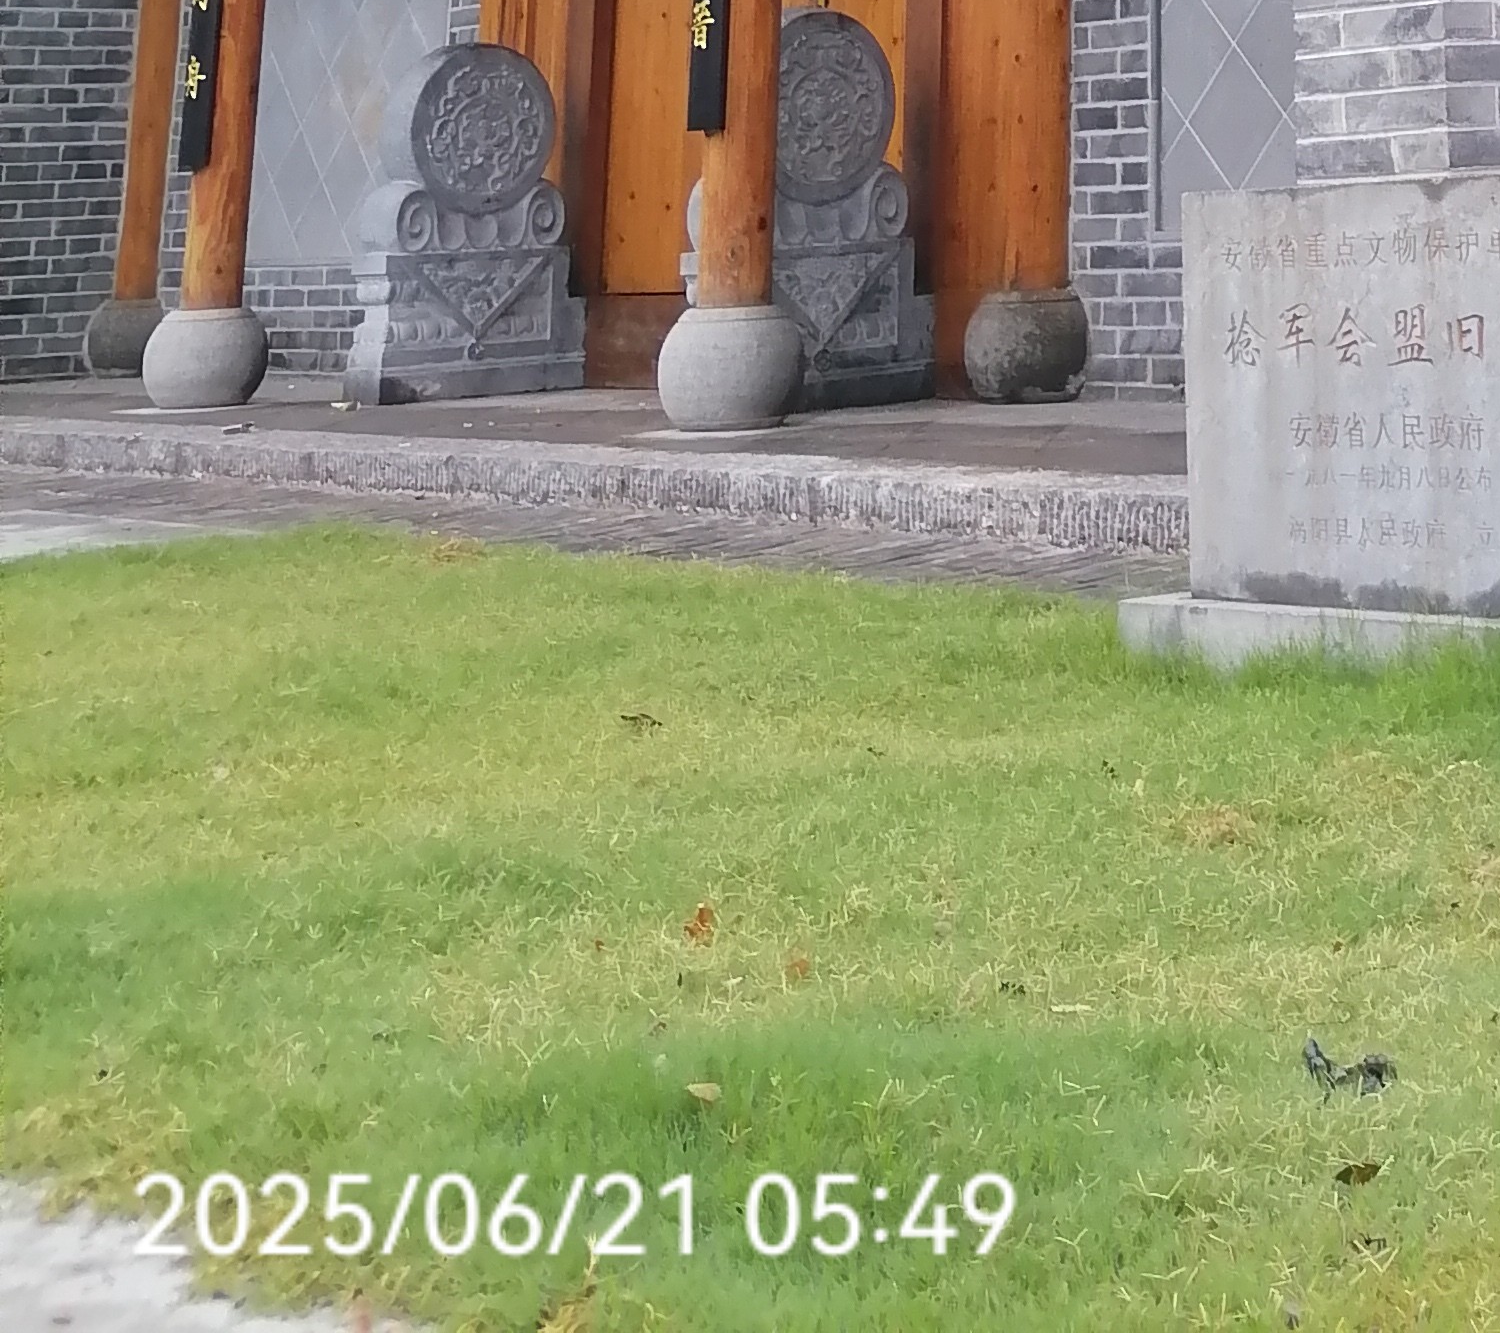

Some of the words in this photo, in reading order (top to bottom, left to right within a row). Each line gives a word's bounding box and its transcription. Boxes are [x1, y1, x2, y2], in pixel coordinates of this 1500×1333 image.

[1289, 412, 1485, 452] 安徽省人民政府
